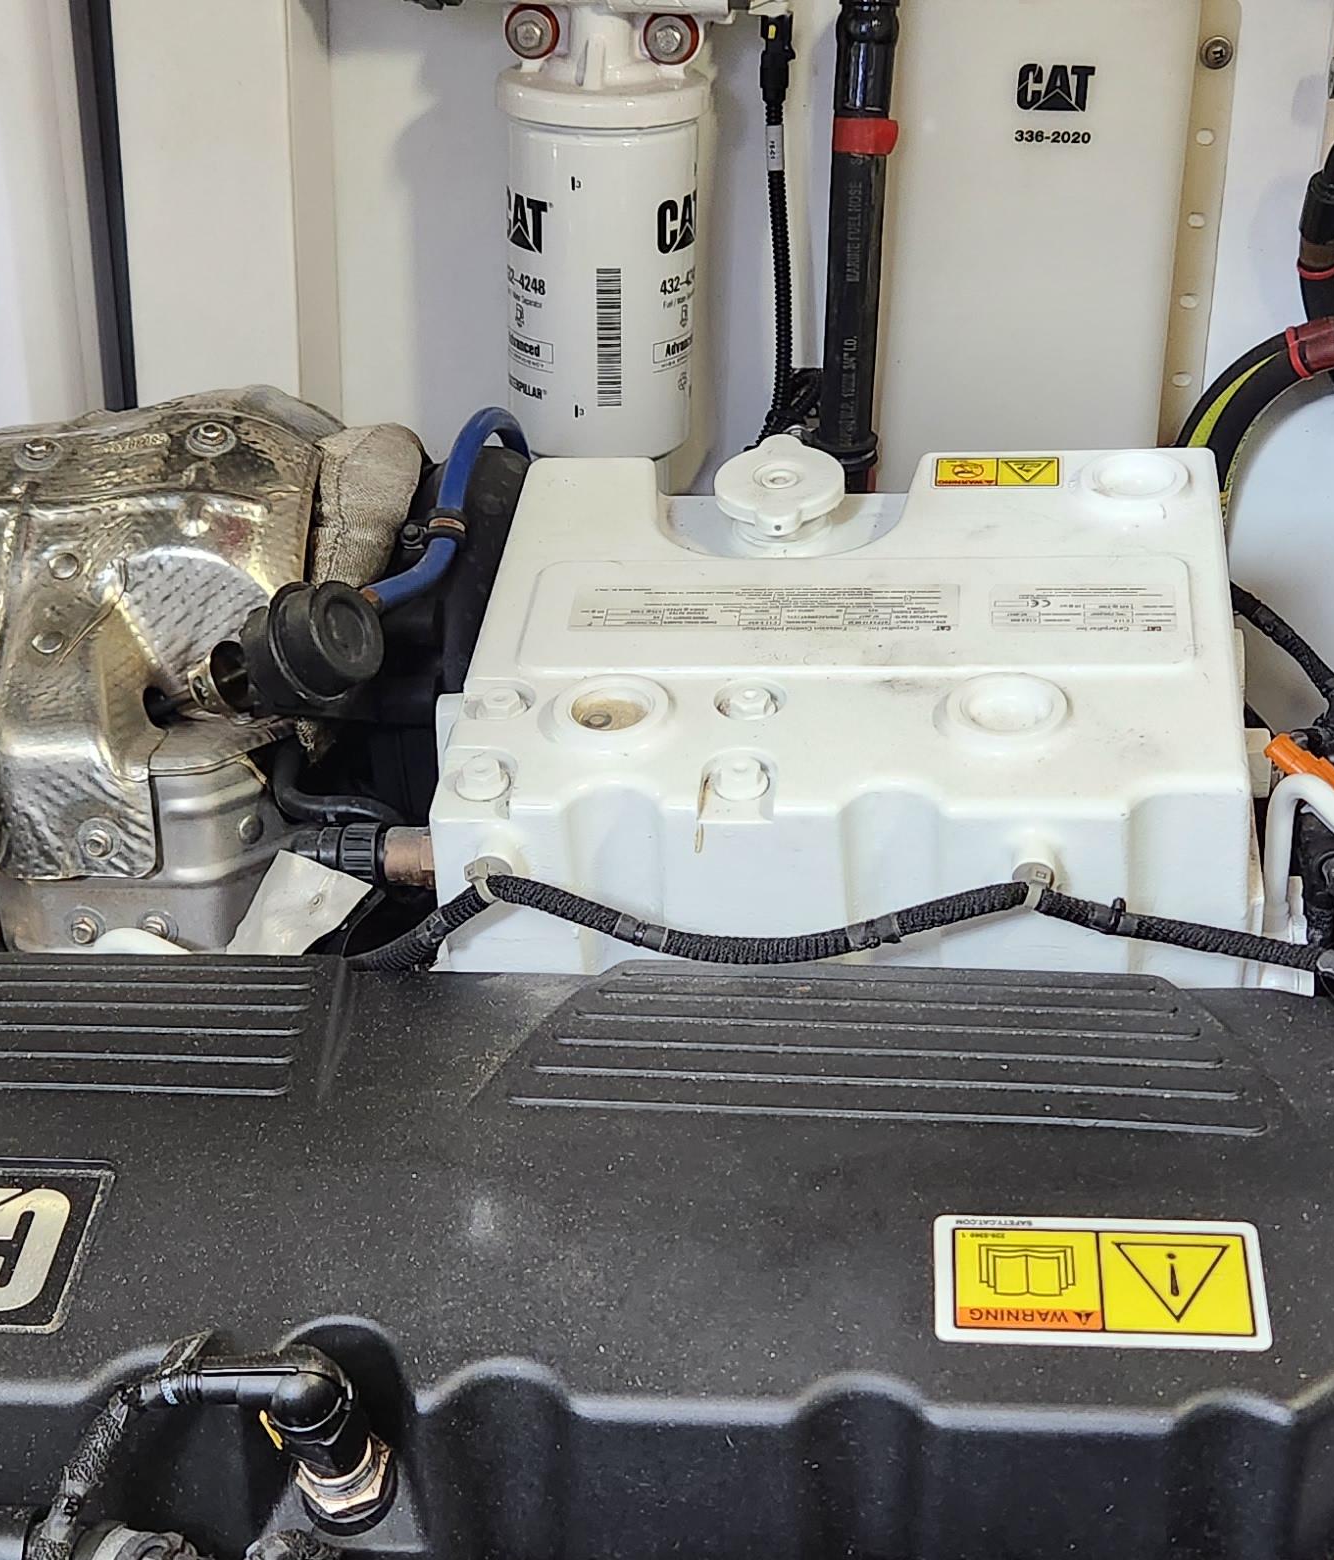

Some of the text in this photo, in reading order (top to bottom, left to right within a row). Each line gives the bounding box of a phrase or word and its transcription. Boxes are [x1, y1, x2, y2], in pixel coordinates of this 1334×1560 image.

[1016, 63, 1096, 112] CAT
[1014, 129, 1091, 144] 336-2020
[848, 181, 862, 212] HOSE
[657, 187, 697, 254] CA
[955, 1218, 1033, 1227] SAFETY.CAT.COM
[969, 1308, 1068, 1323] WARNING
